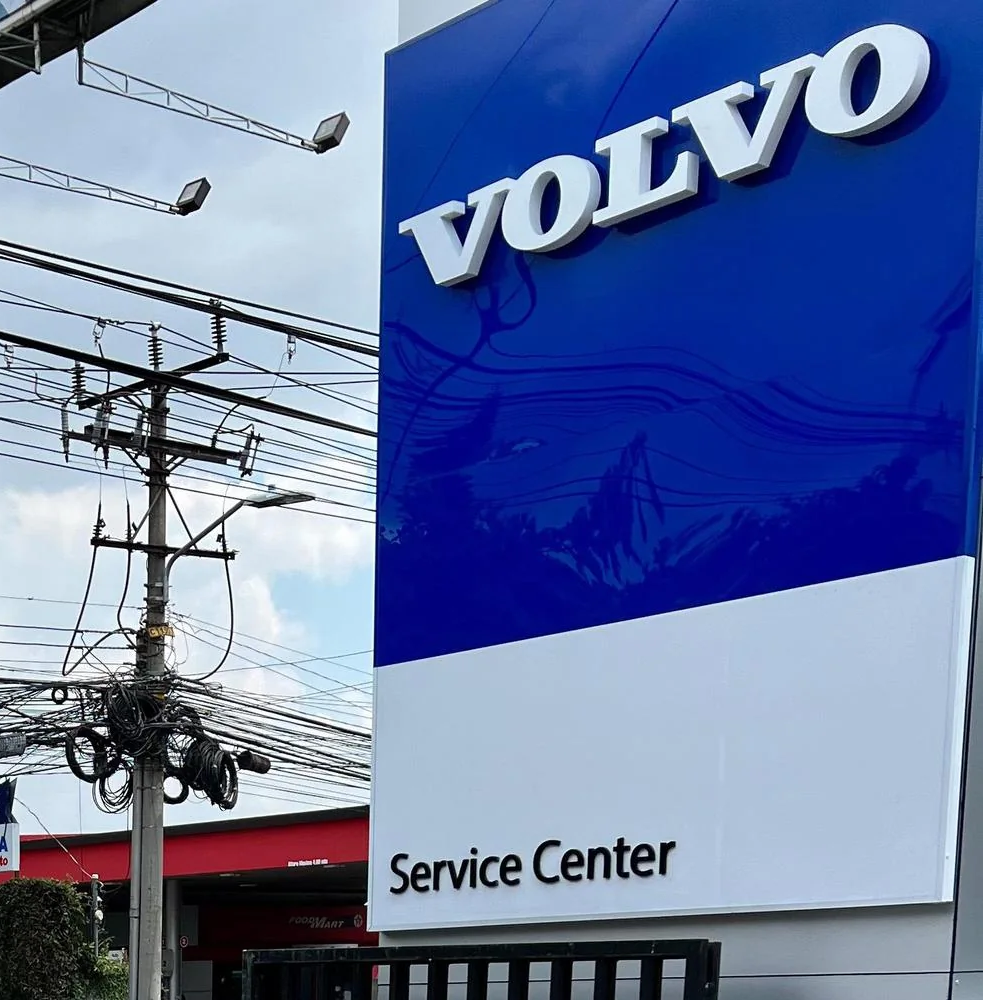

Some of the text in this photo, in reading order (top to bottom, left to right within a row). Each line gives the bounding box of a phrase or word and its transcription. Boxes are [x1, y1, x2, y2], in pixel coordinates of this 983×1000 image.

[398, 23, 931, 287] VOLVO
[389, 837, 676, 895] Service Center
